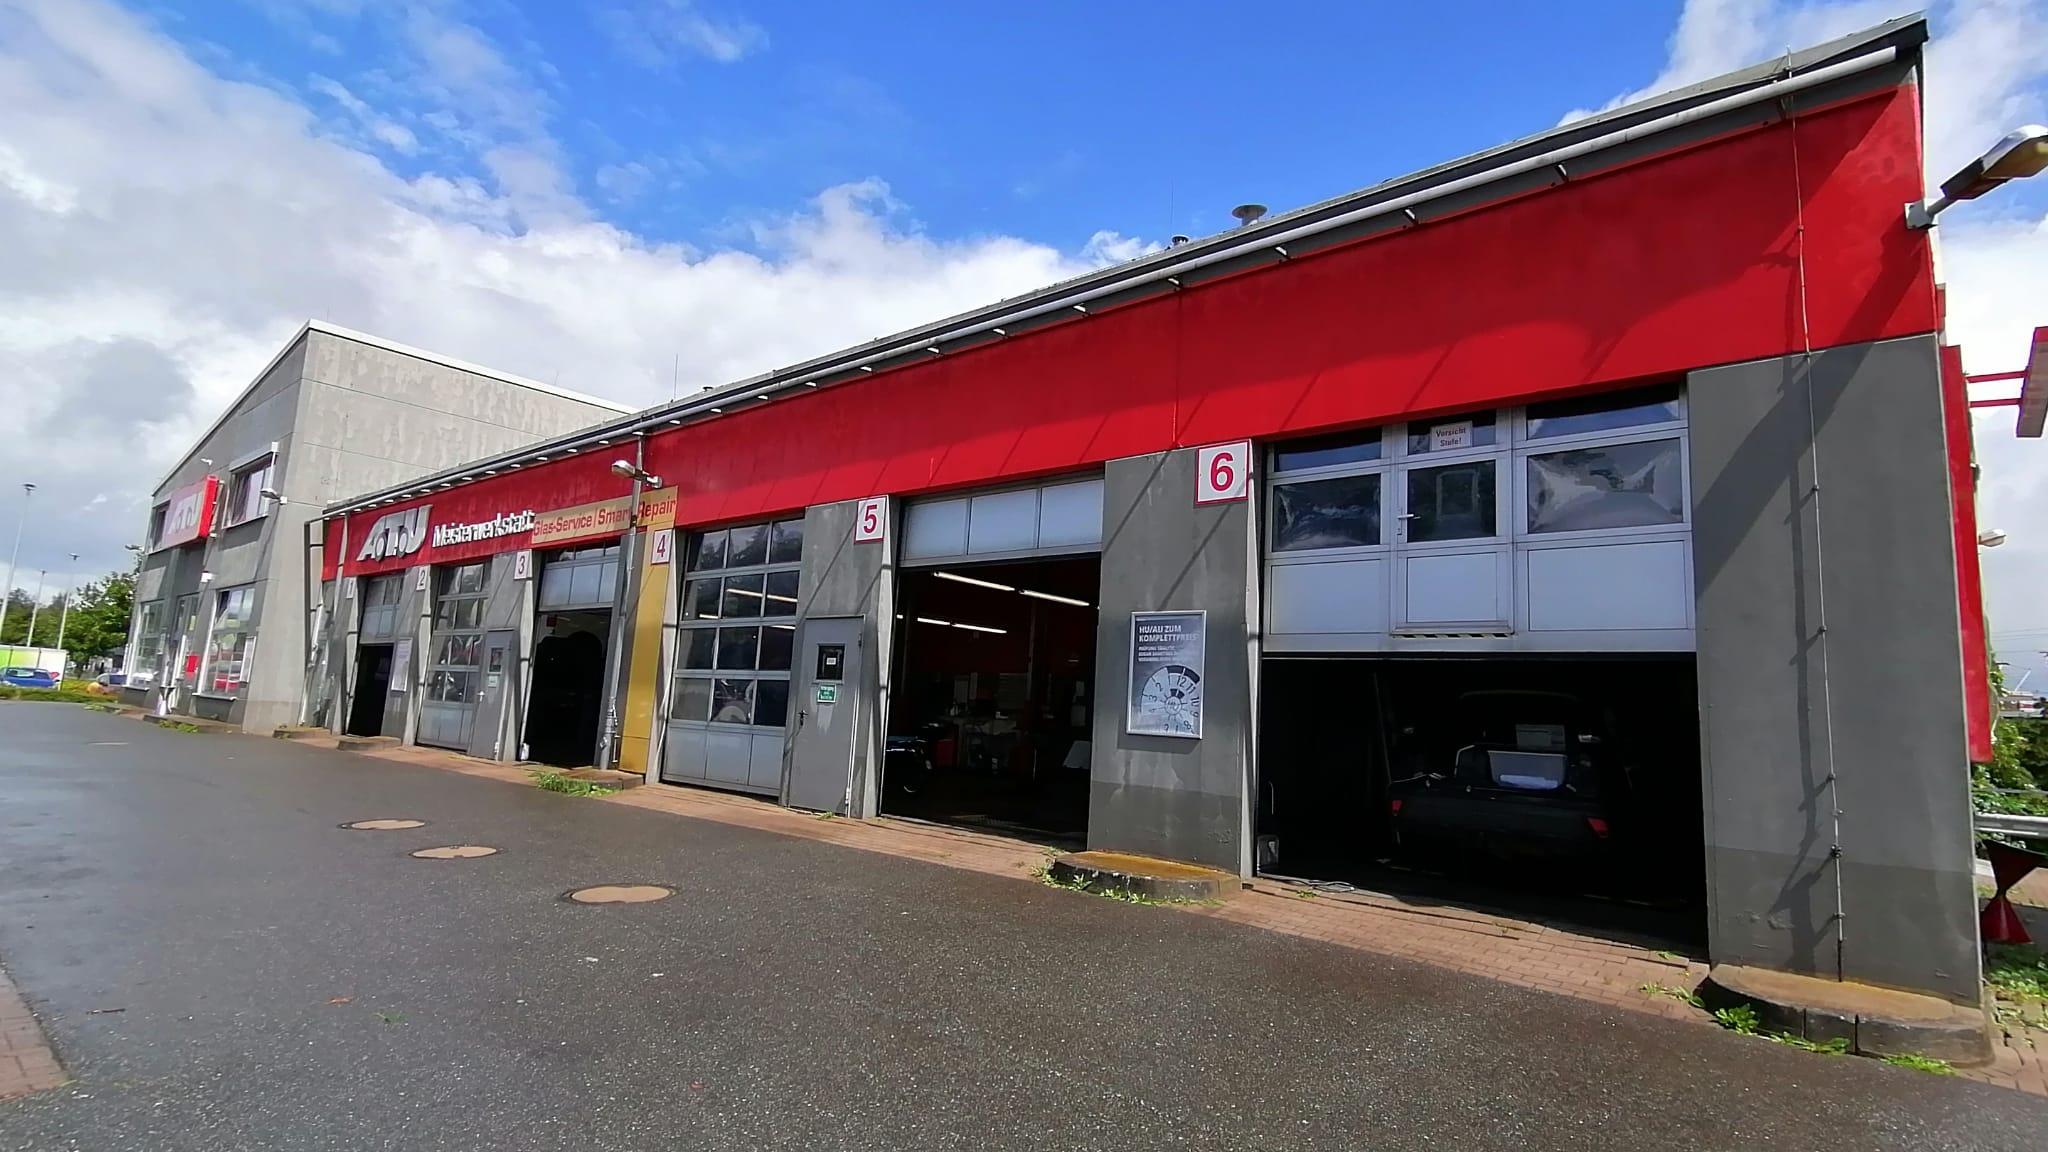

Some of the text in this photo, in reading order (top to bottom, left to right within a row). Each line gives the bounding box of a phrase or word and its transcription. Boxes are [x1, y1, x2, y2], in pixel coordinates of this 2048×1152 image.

[1436, 427, 1466, 437] Vorsicht
[1440, 437, 1462, 447] Stufe!
[1210, 452, 1234, 492] 6
[533, 512, 592, 536] Glas-Service
[598, 506, 631, 526] Smar
[638, 496, 676, 521] Repair
[863, 504, 878, 534] 5
[432, 510, 536, 547] Meisterwerkstatt
[656, 534, 666, 558] 4
[518, 555, 526, 575] 3
[418, 569, 426, 587] 2
[1139, 624, 1182, 634] HU/AU ZUM
[1155, 682, 1163, 692] 2
[1177, 675, 1187, 688] 12
[1186, 683, 1196, 695] 11
[1184, 720, 1191, 730] 8
